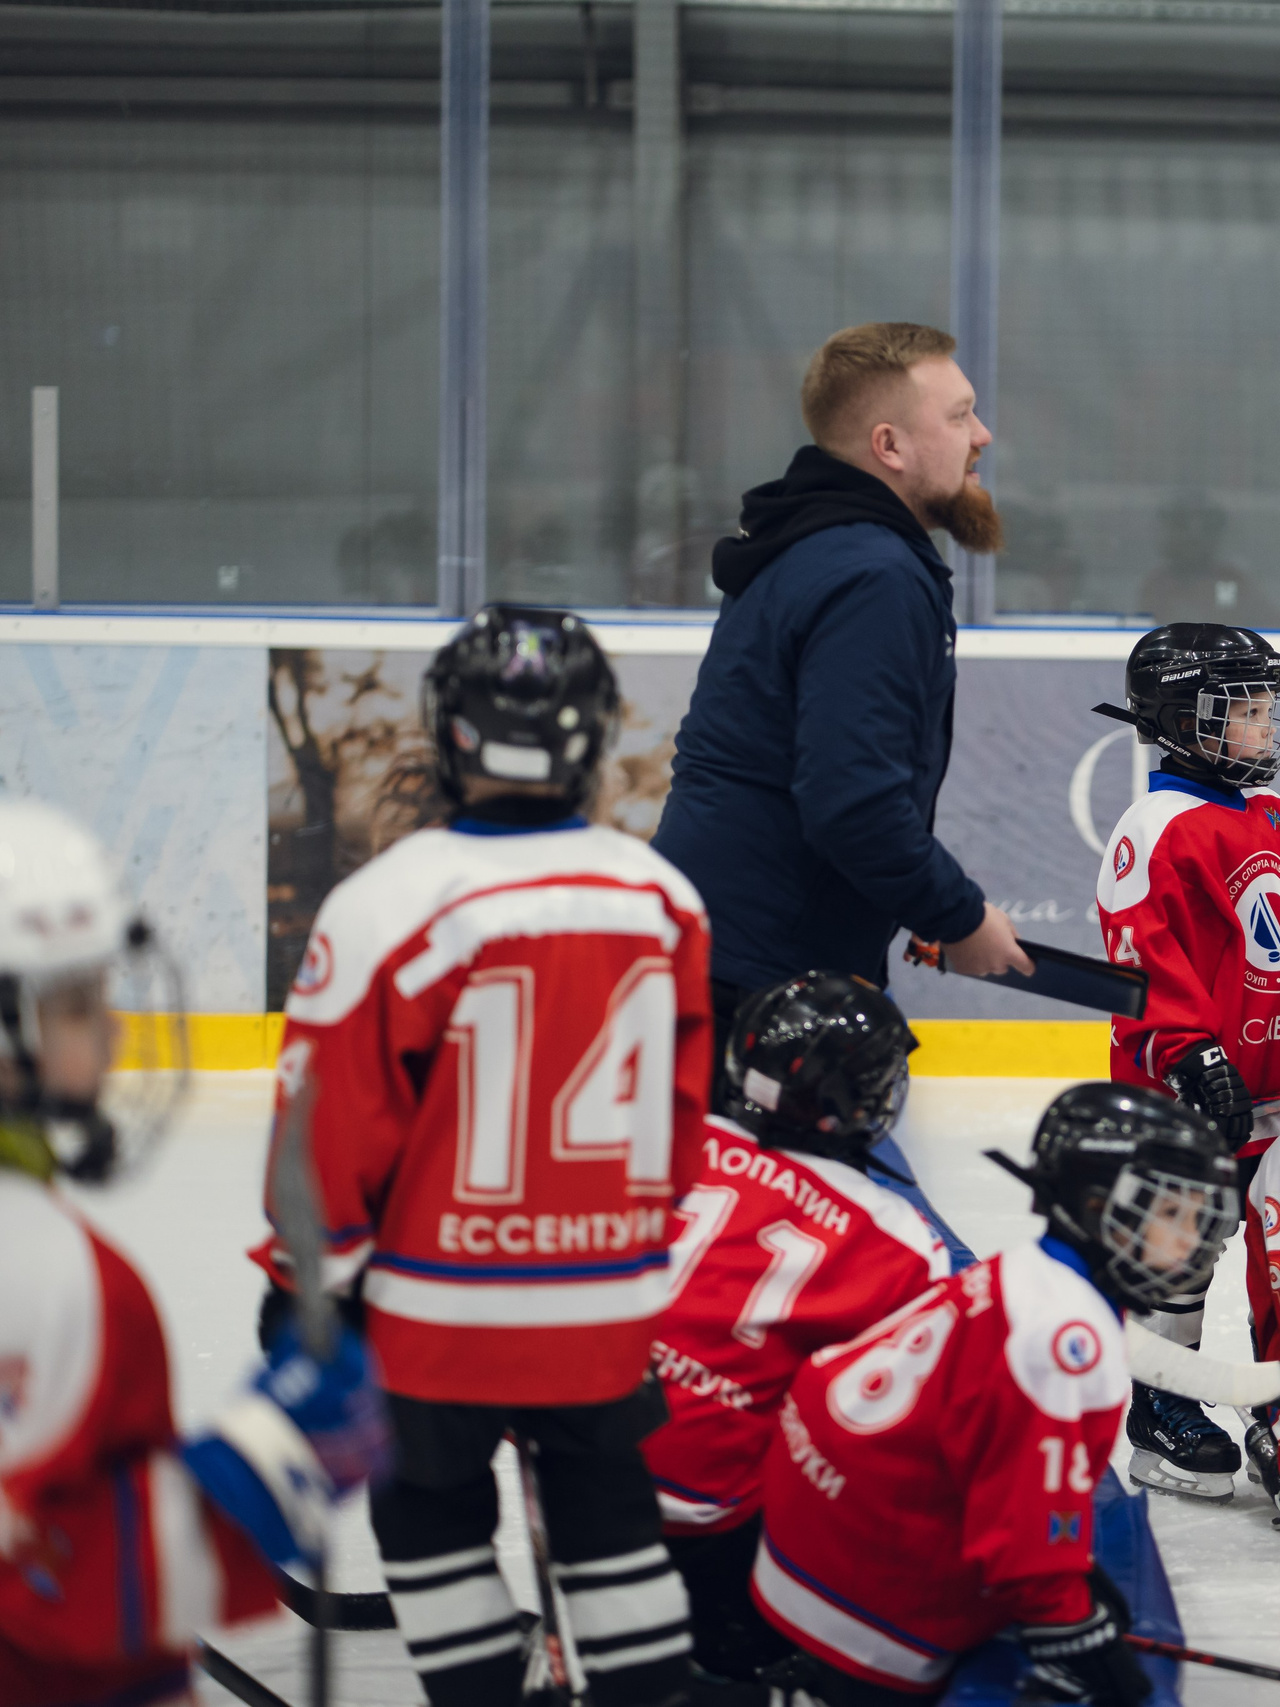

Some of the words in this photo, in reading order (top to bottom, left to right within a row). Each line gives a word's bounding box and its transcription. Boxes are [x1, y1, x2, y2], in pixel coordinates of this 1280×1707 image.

[1160, 668, 1202, 683] BAUER
[1157, 735, 1192, 757] BAUER
[443, 955, 675, 1205] 14
